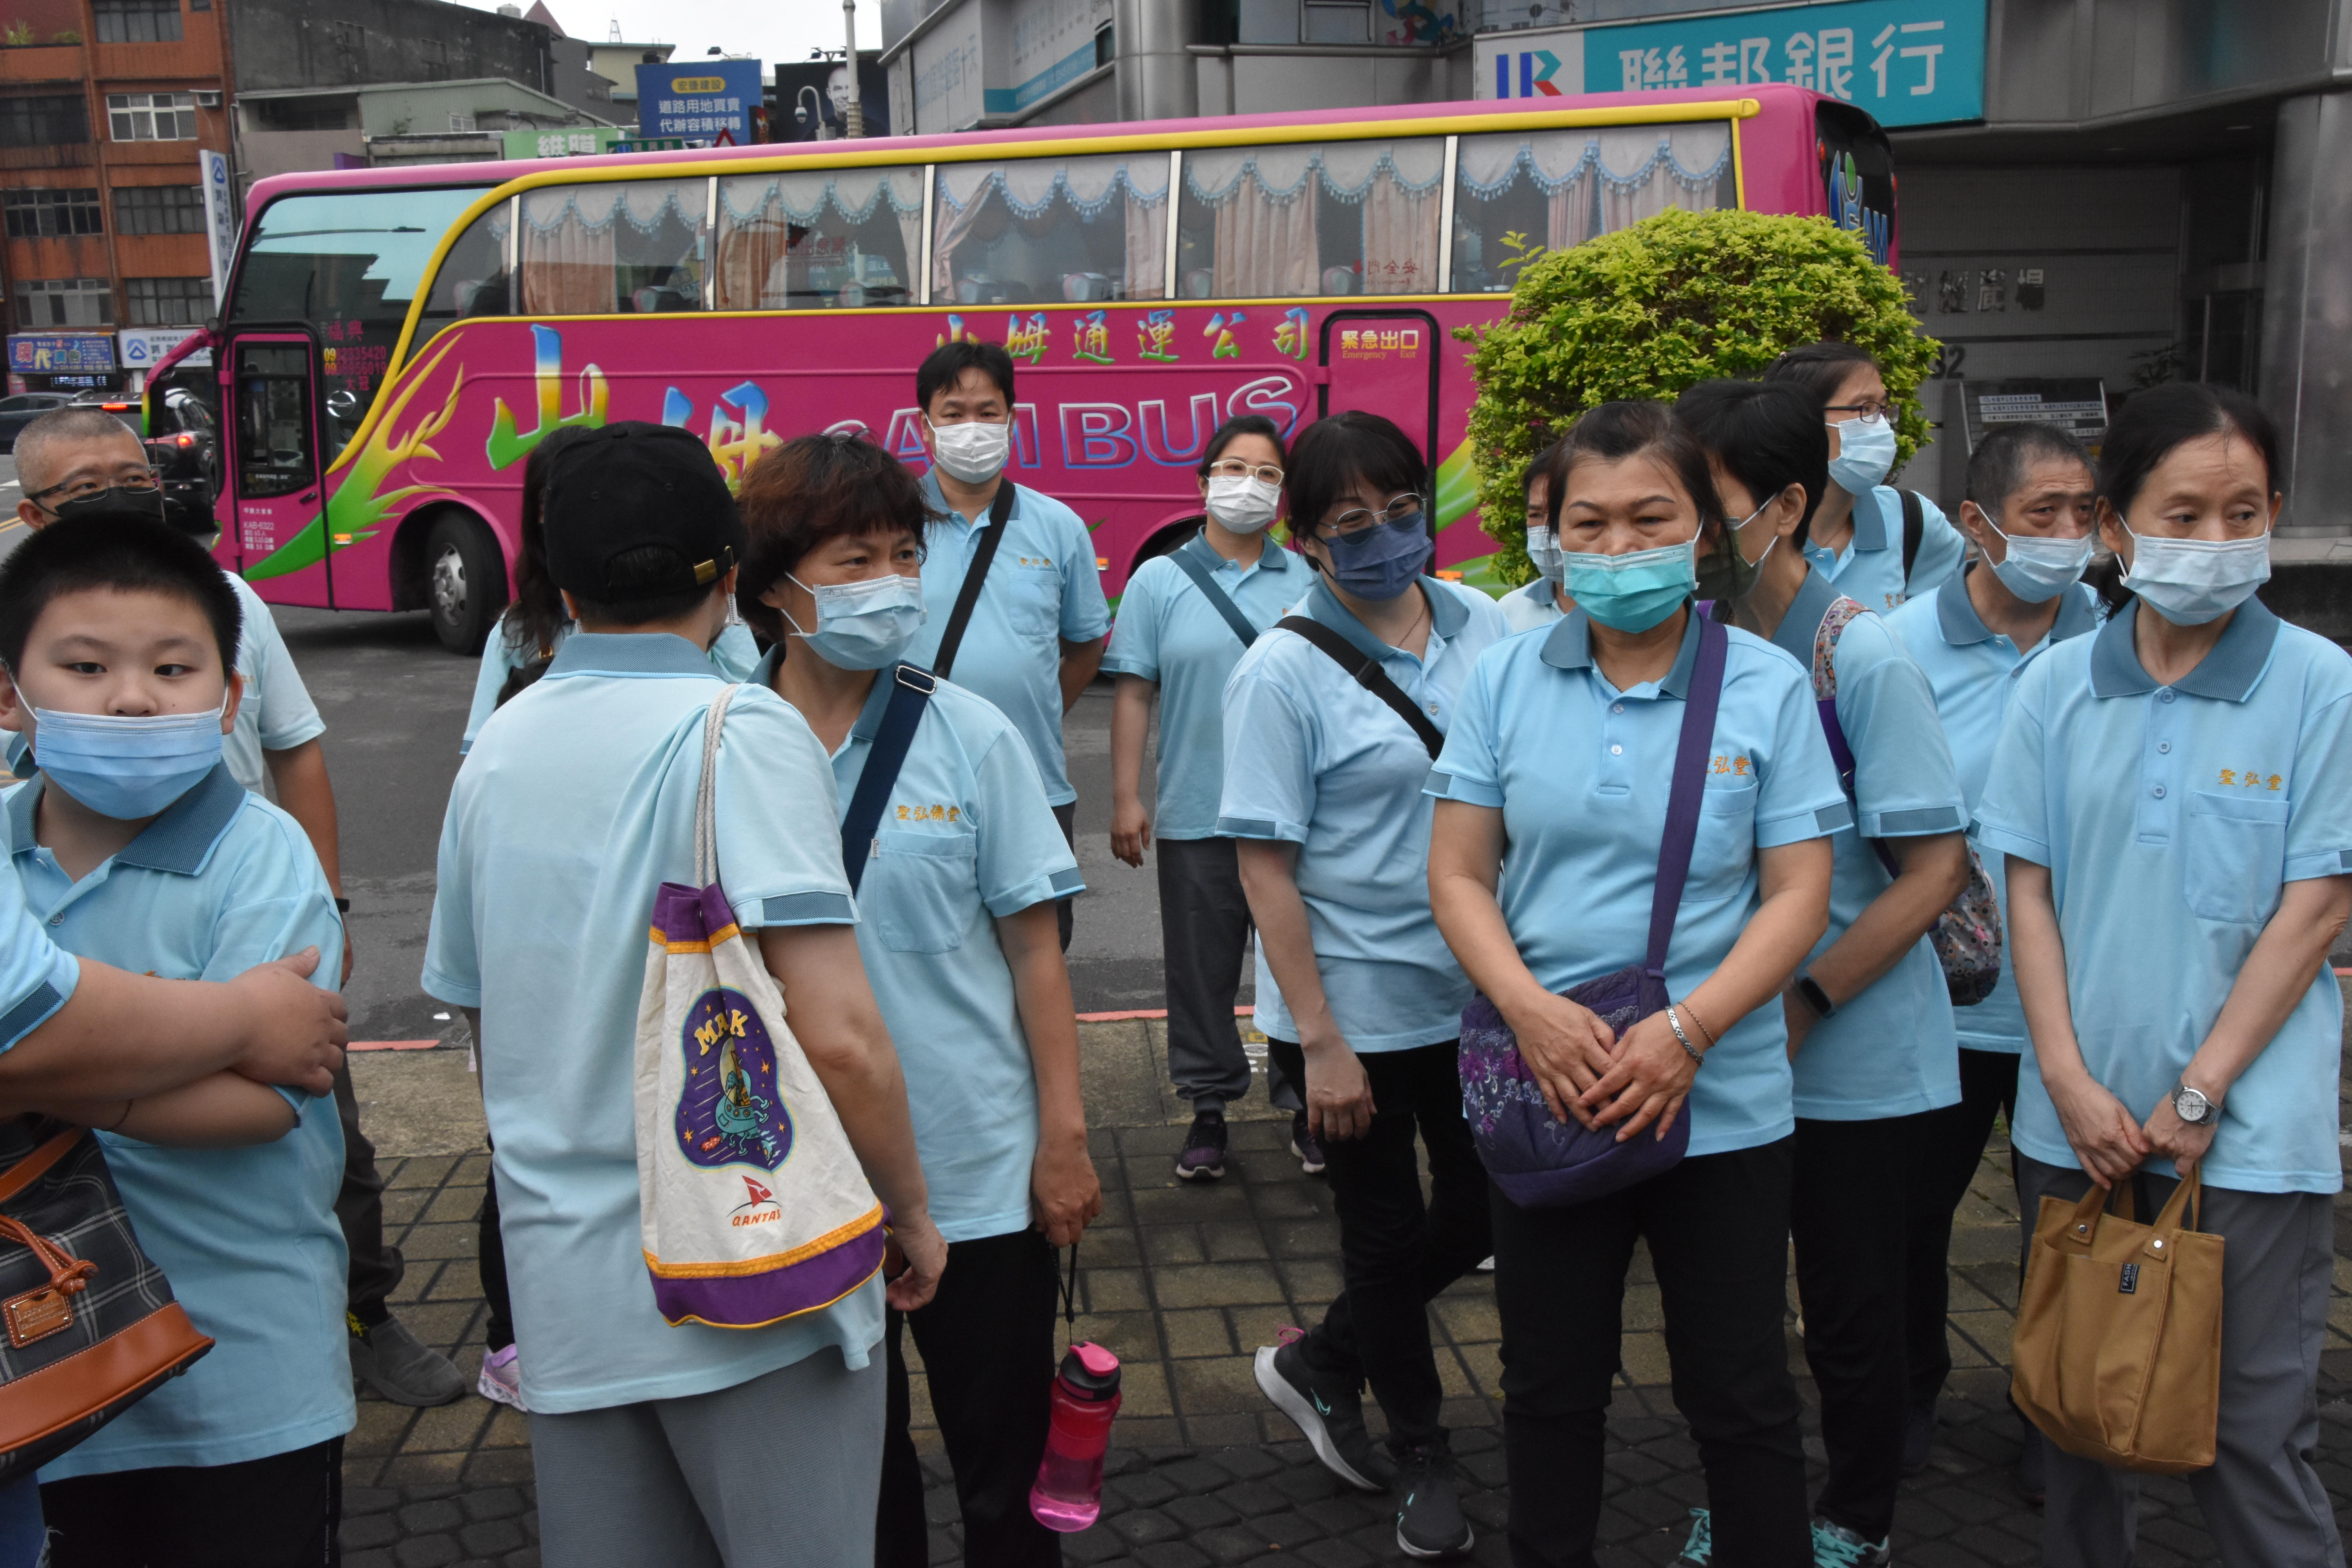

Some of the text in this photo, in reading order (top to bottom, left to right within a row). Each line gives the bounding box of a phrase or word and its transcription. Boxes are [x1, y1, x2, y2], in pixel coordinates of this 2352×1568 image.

[1619, 20, 1944, 100] 聯邦銀行
[659, 98, 740, 113] 道路用地買賣
[1341, 330, 1419, 350] 緊急出口
[1343, 350, 1416, 360] Emergency Exit
[1059, 376, 1297, 470] BUS
[1706, 755, 1751, 776] 弘堂
[2218, 769, 2283, 791] 聖弘堂
[896, 804, 961, 822] 聖弘佛堂
[732, 1208, 782, 1227] QANTAS
